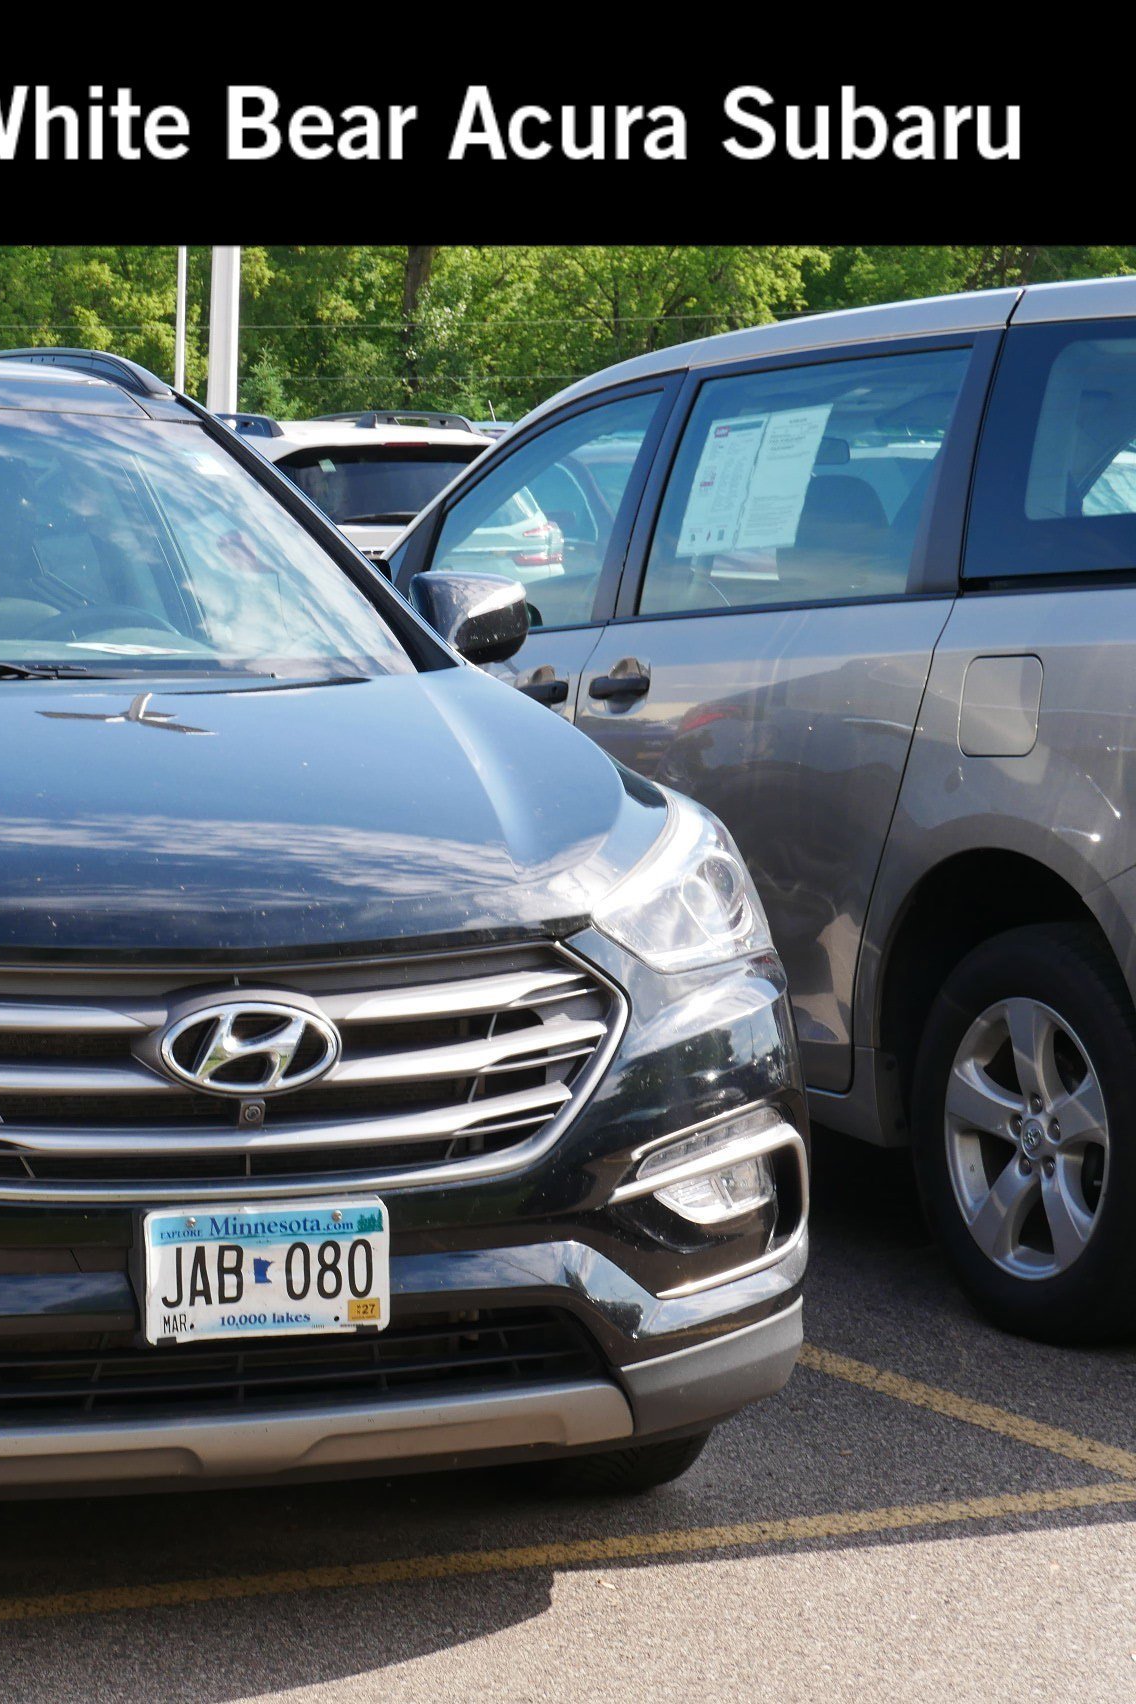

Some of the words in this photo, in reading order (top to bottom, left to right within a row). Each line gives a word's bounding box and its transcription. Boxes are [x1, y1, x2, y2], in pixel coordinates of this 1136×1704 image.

[161, 1244, 244, 1308] JAB
[285, 1239, 373, 1301] 080
[362, 1303, 376, 1315] 27
[220, 1312, 268, 1329] 10,000
[272, 1311, 311, 1325] lakes
